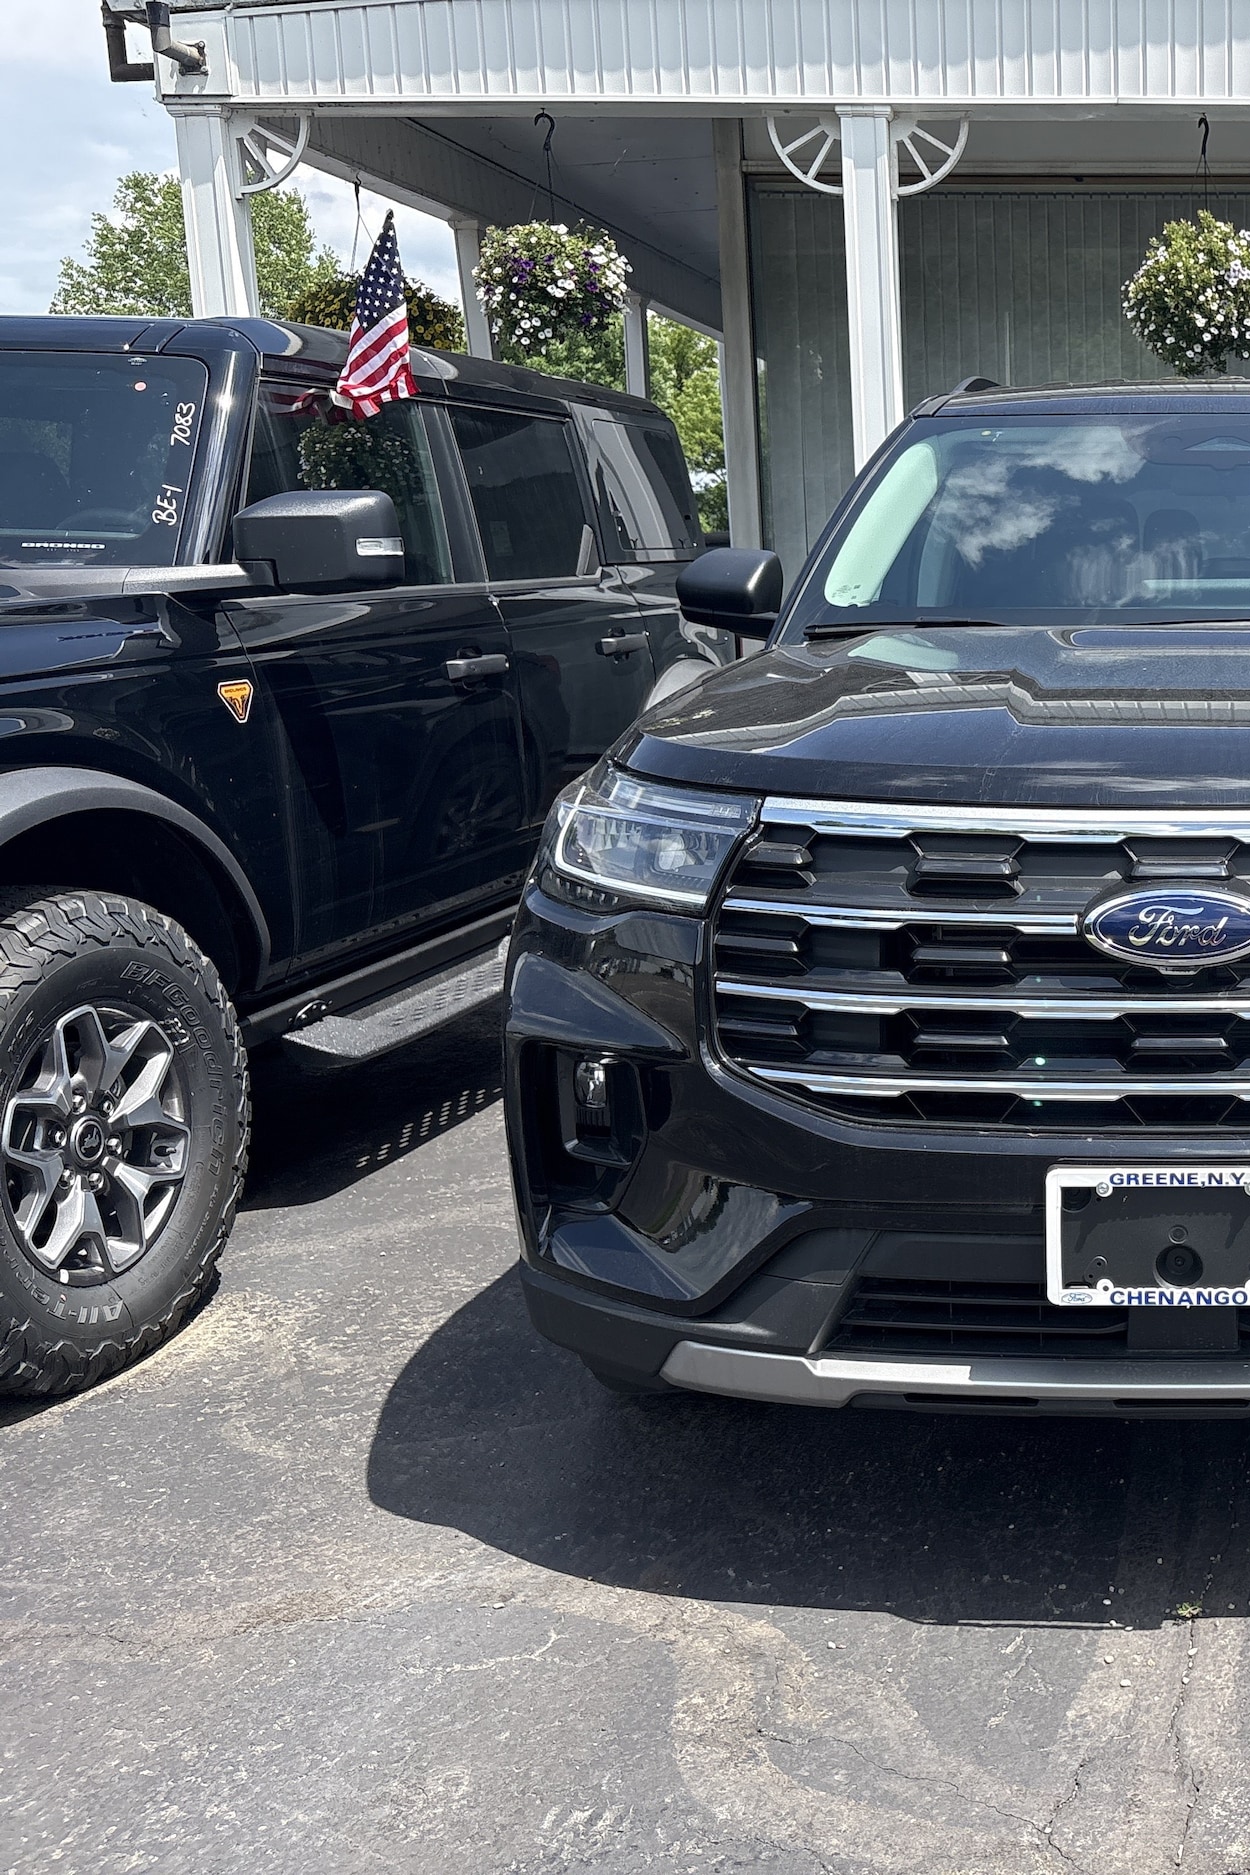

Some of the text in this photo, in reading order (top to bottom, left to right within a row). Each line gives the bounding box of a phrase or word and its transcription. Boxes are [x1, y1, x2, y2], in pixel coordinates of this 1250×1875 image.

[170, 402, 196, 446] 7083
[1128, 905, 1229, 947] Ford
[120, 960, 226, 1177] BFGoodrich
[1067, 1292, 1088, 1303] Ford
[1109, 1290, 1248, 1306] CHENANGO
